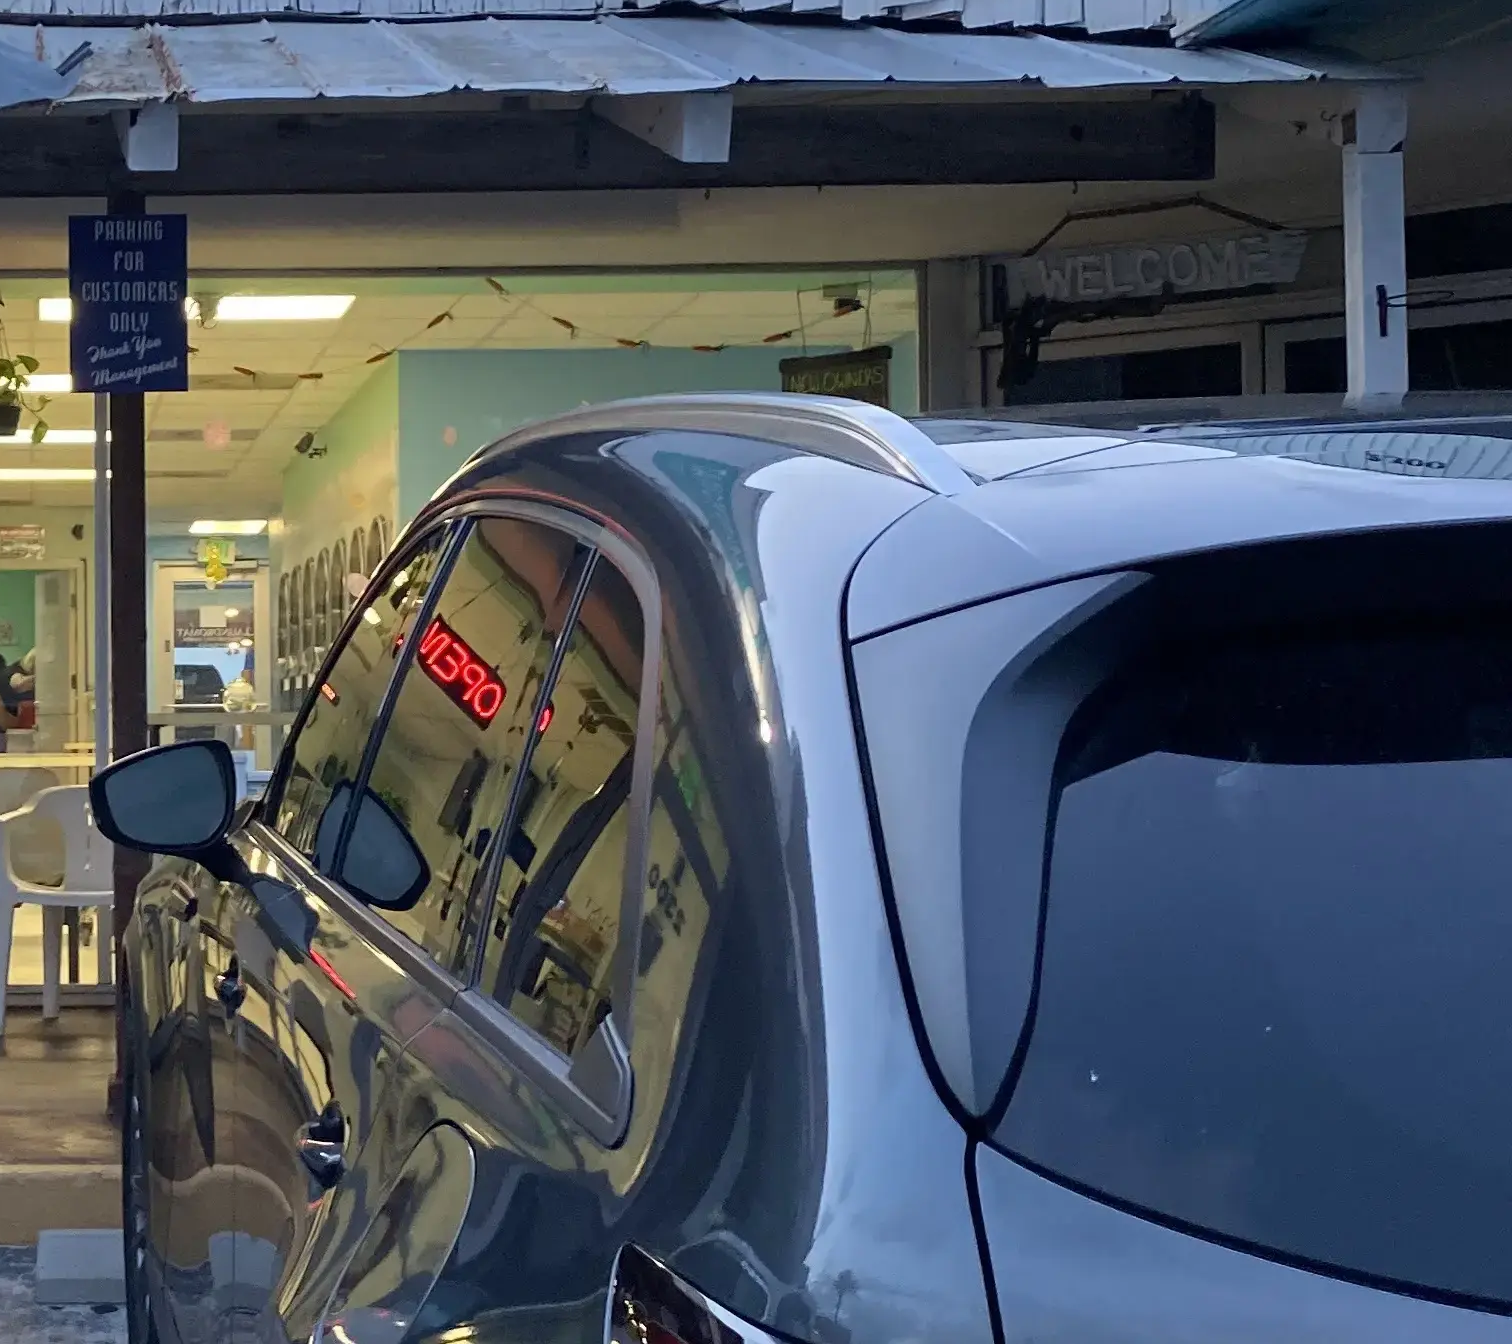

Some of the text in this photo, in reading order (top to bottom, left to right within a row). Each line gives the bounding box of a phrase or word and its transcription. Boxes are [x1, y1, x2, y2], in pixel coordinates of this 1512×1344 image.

[94, 220, 164, 242] PARKING
[113, 250, 145, 272] FOR
[1037, 236, 1270, 302] WELCOME
[81, 281, 179, 302] CUSTOMERS
[109, 311, 150, 333] ONLY
[87, 336, 162, 363] Thank You
[90, 356, 179, 386] Management
